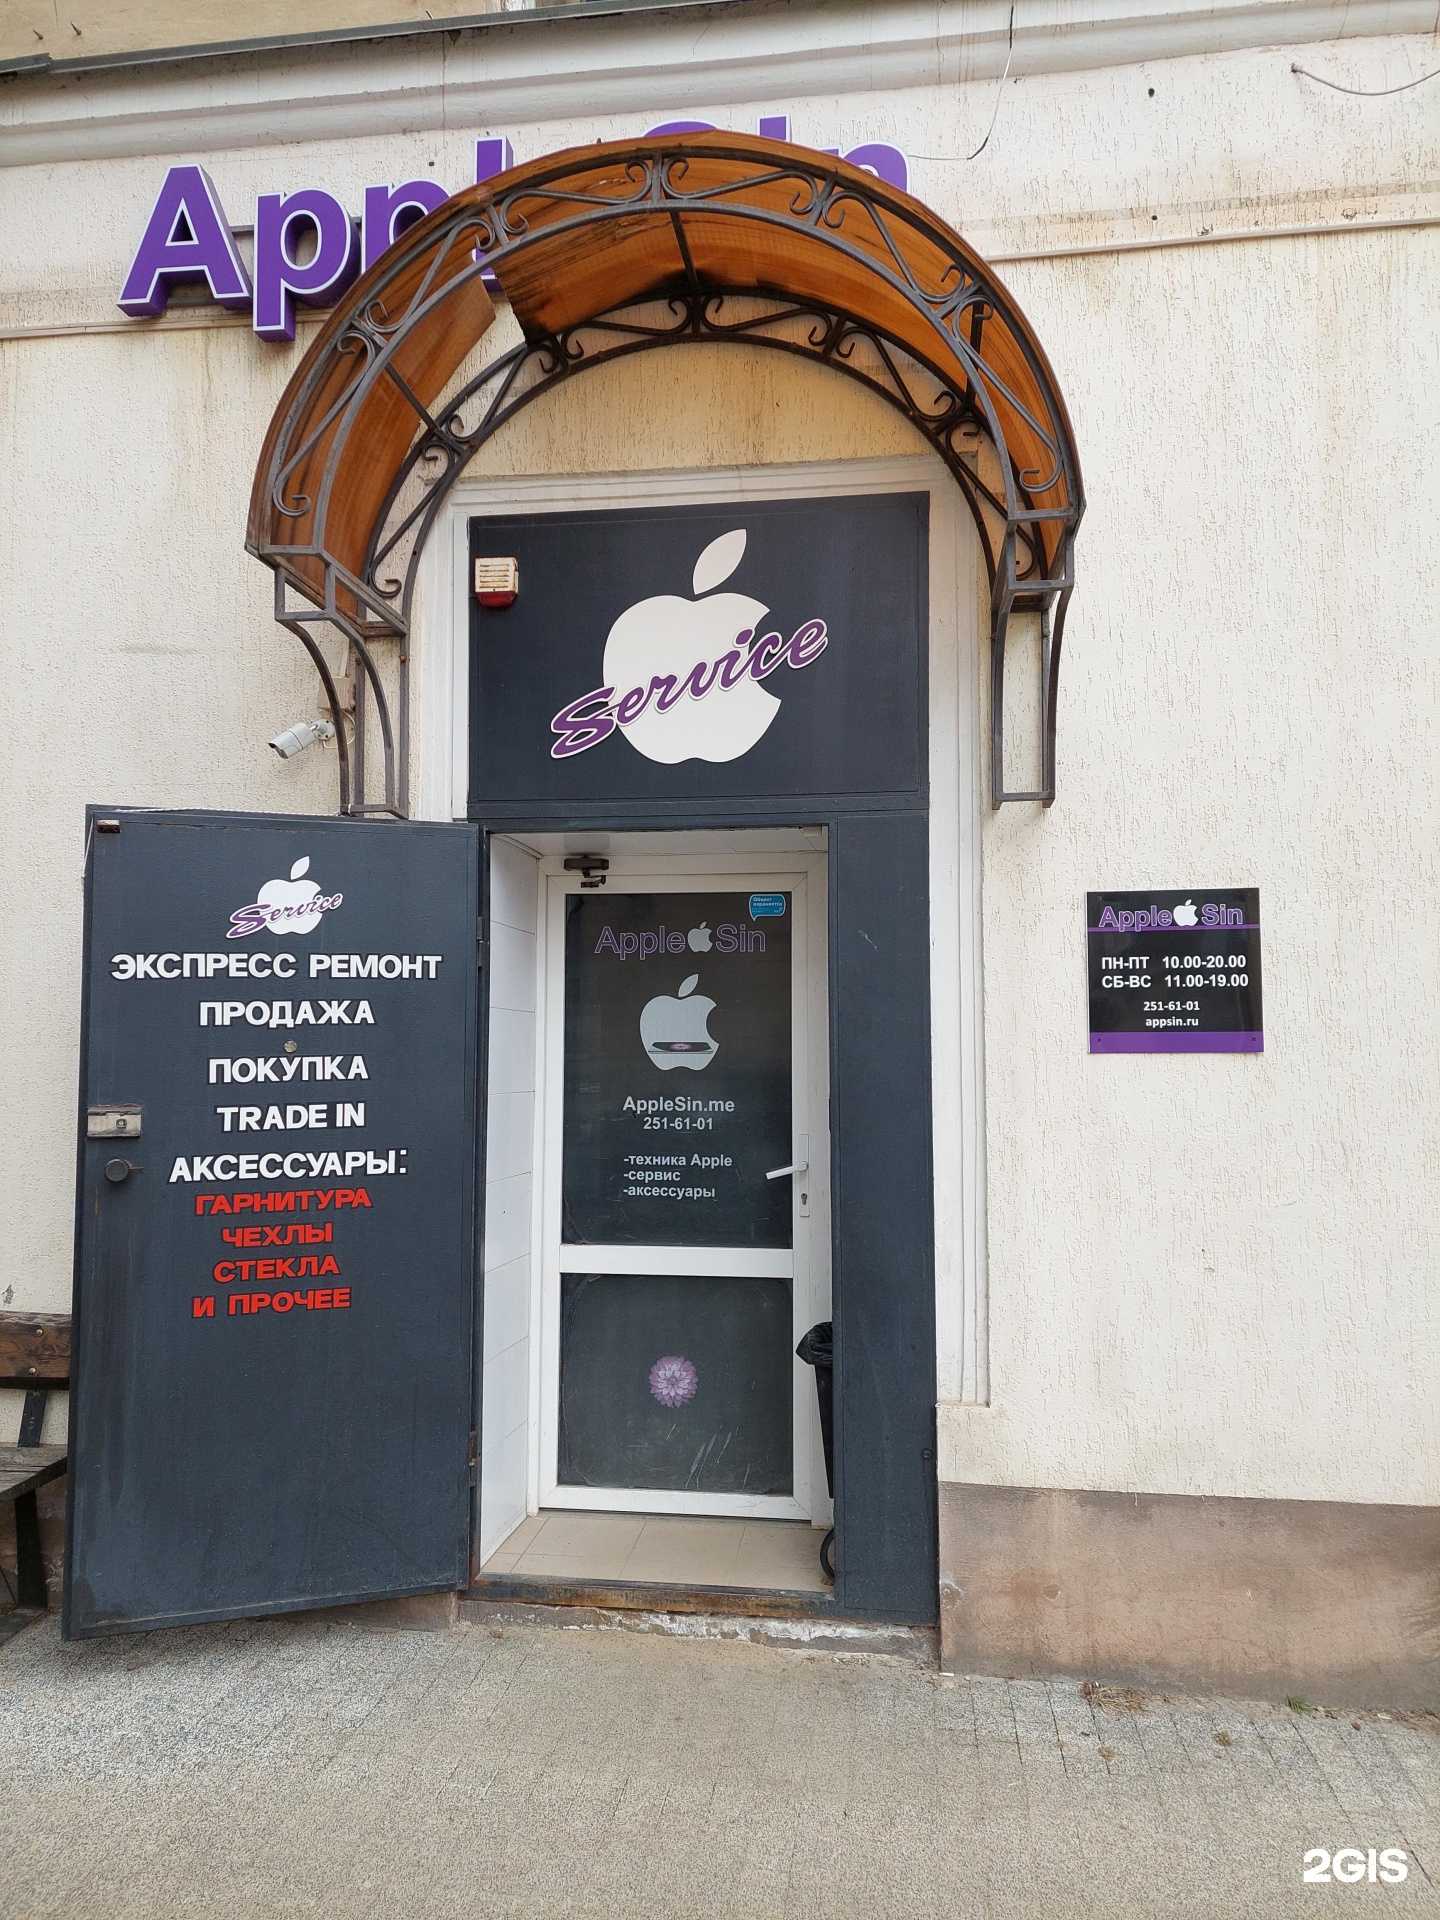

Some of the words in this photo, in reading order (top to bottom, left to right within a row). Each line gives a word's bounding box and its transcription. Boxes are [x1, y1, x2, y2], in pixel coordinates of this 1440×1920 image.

[550, 618, 828, 759] Service
[225, 891, 343, 939] Service
[1099, 905, 1173, 932] Apple
[1202, 903, 1244, 926] Sin
[594, 925, 687, 960] Apple
[715, 923, 767, 953] Sin
[110, 953, 296, 980] ЭКСПРЕСС
[308, 953, 443, 980] РЕМОНТ
[1101, 956, 1150, 970] ПН-ПТ
[1162, 955, 1247, 969] 10.00-20.00
[1102, 975, 1152, 989] СБ-ВС
[1164, 973, 1249, 988] 11.00-19.00
[199, 1000, 376, 1029] ПРОДАЖА
[1143, 1001, 1200, 1011] 251-61-01
[1145, 1016, 1200, 1028] appsin.ru
[208, 1054, 370, 1084] ПОКУПКА
[216, 1103, 328, 1132] TRADE
[335, 1102, 366, 1129] IN
[622, 1095, 736, 1114] AppleSin.me
[643, 1117, 713, 1130] 251-61-01
[169, 1148, 408, 1184] АКСЕССУАРЫ:
[623, 1155, 687, 1166] -техника
[690, 1154, 733, 1168] Apple
[623, 1171, 681, 1182] -сервис
[194, 1187, 372, 1216] ГАРНИТУРА
[623, 1186, 716, 1200] -аксессуары
[221, 1222, 334, 1248] ЧЕХЛЫ
[212, 1254, 341, 1283] СТЕКЛА
[192, 1296, 216, 1318] И
[228, 1287, 352, 1316] ПРОЧЕЕ
